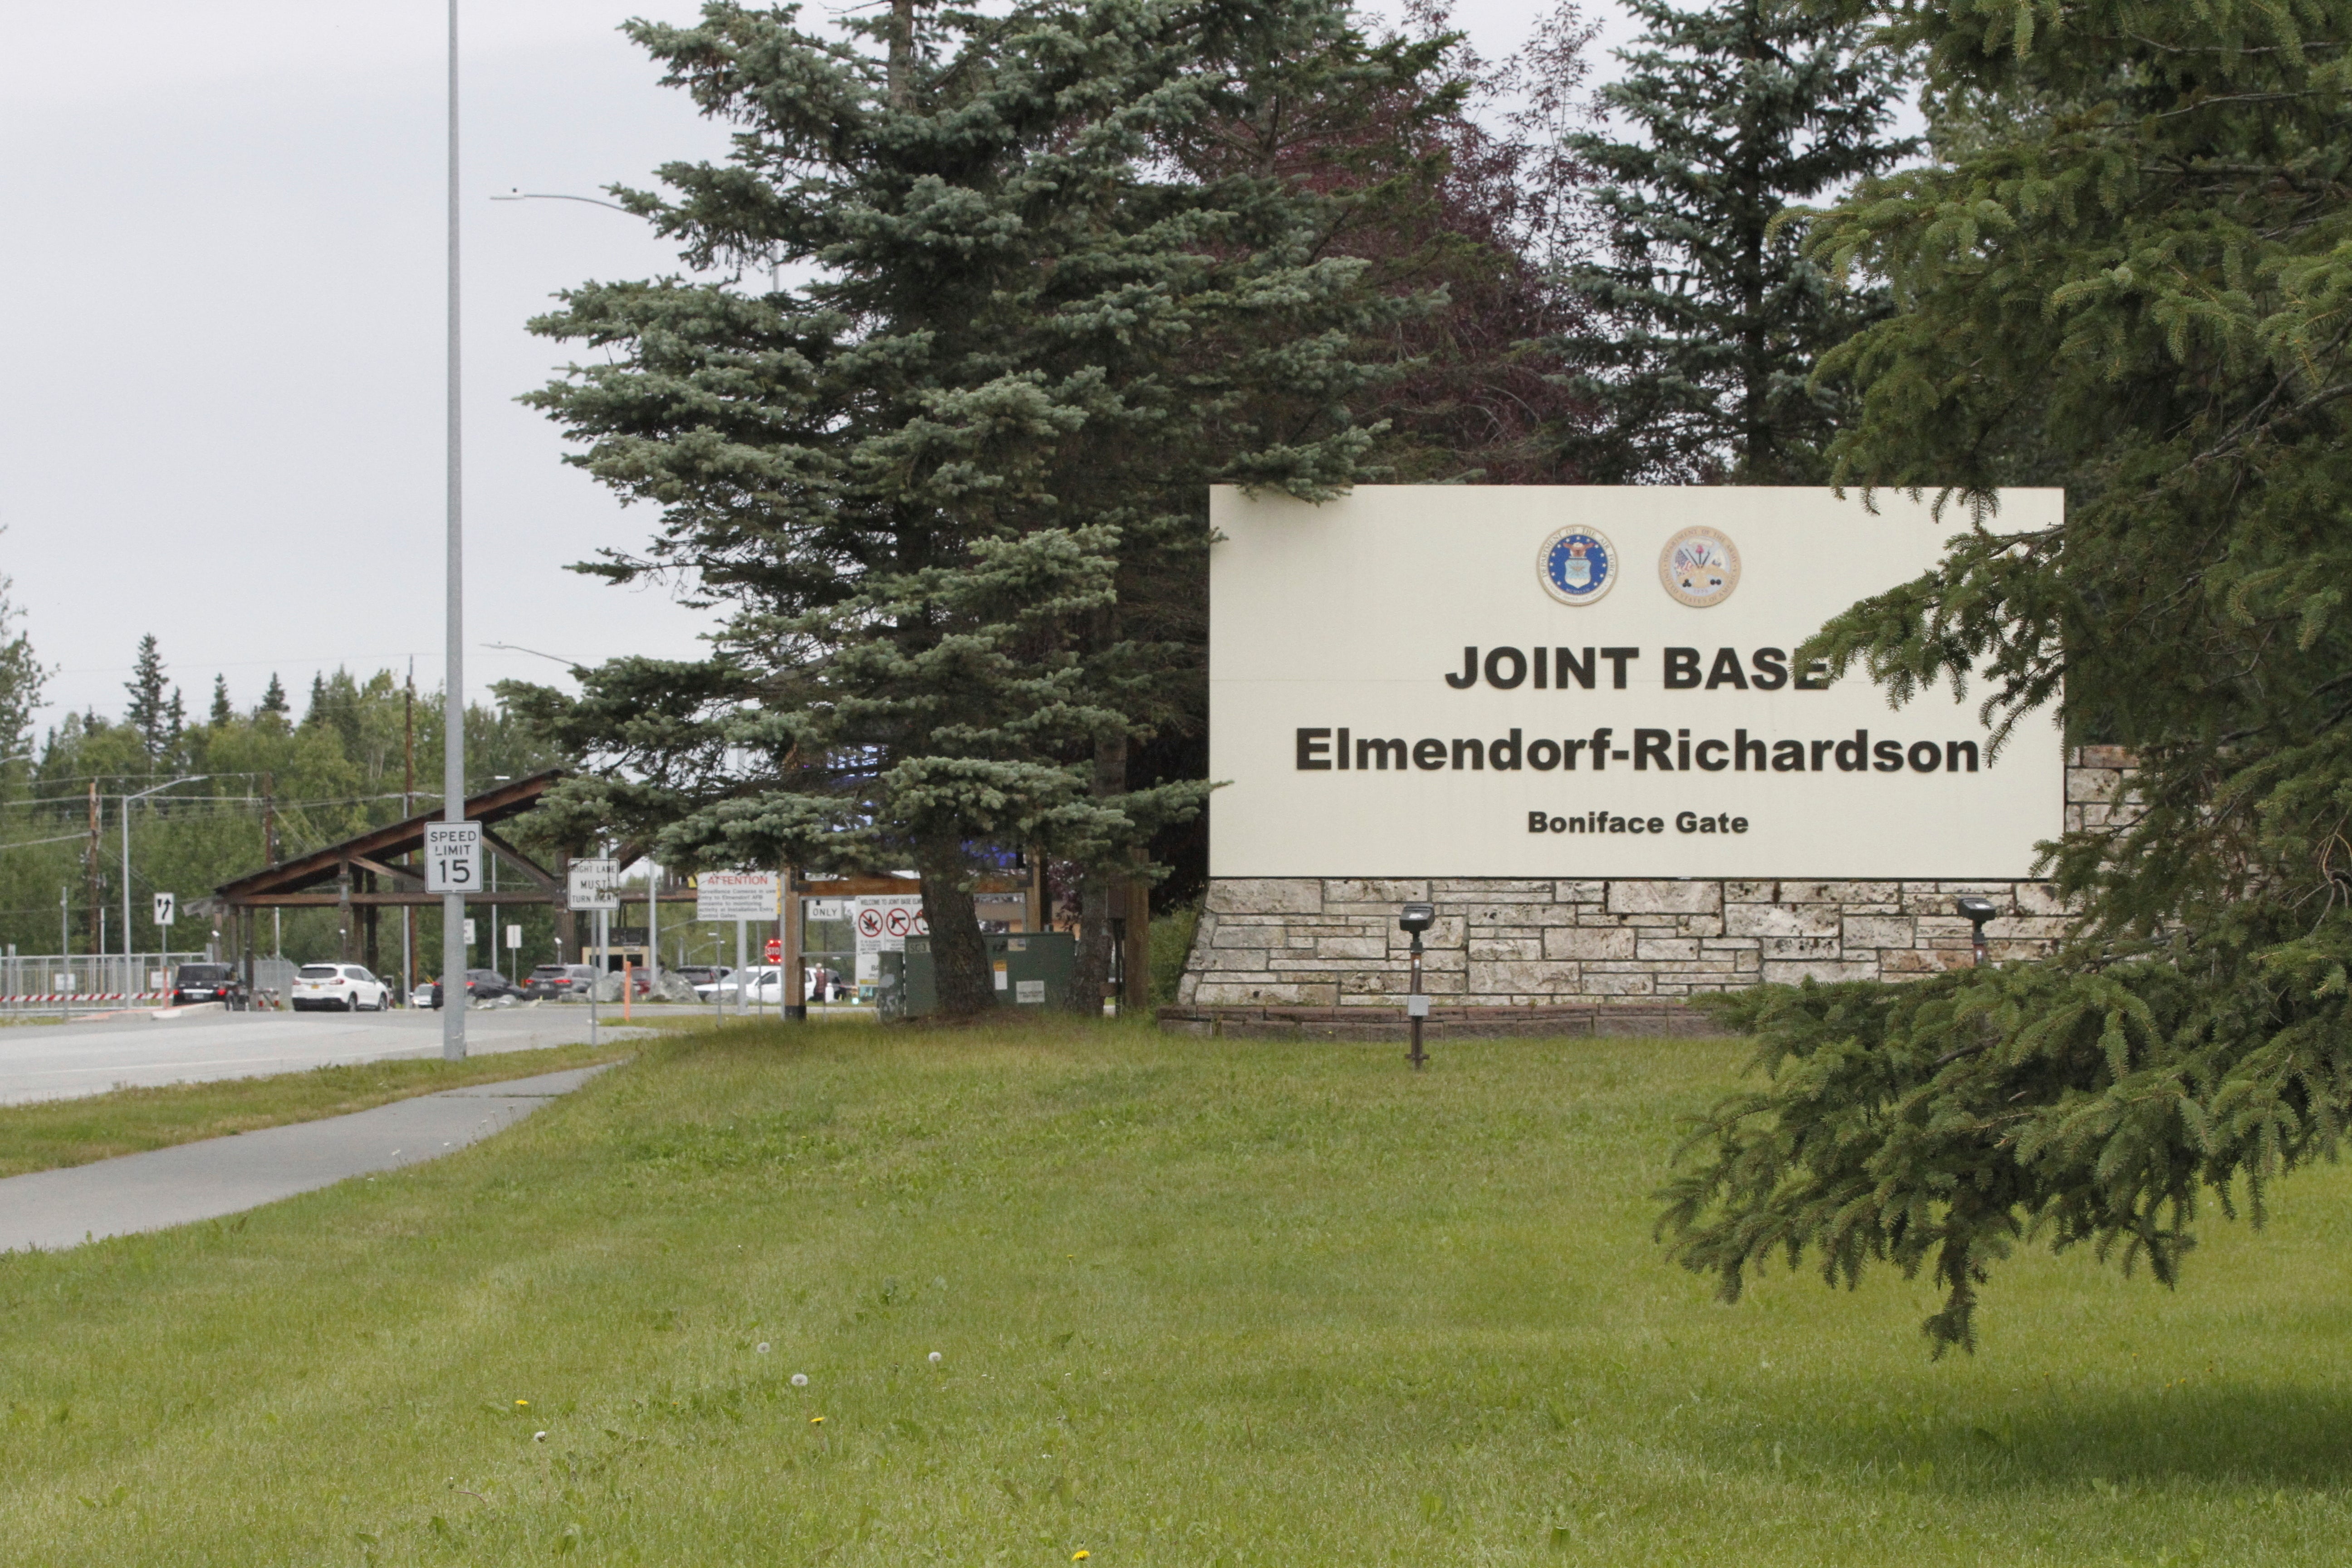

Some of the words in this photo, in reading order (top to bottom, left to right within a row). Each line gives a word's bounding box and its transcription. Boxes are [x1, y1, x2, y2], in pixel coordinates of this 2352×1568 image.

[1540, 532, 1562, 578] DEPARTMENT
[1582, 528, 1596, 537] THE
[1598, 538, 1611, 549] AIR
[1607, 554, 1616, 578] FORCE
[1446, 646, 1639, 690] JOINT
[1296, 728, 1979, 773] Elmendorf-Richardson
[1529, 811, 1664, 834] Boniface
[1676, 811, 1749, 834] Gate
[431, 831, 476, 843] SPEED
[435, 845, 471, 856] LIMIT
[440, 859, 470, 883] 15
[581, 880, 606, 889] MUST
[708, 876, 768, 885] ATTENTION
[813, 908, 838, 916] ONLY
